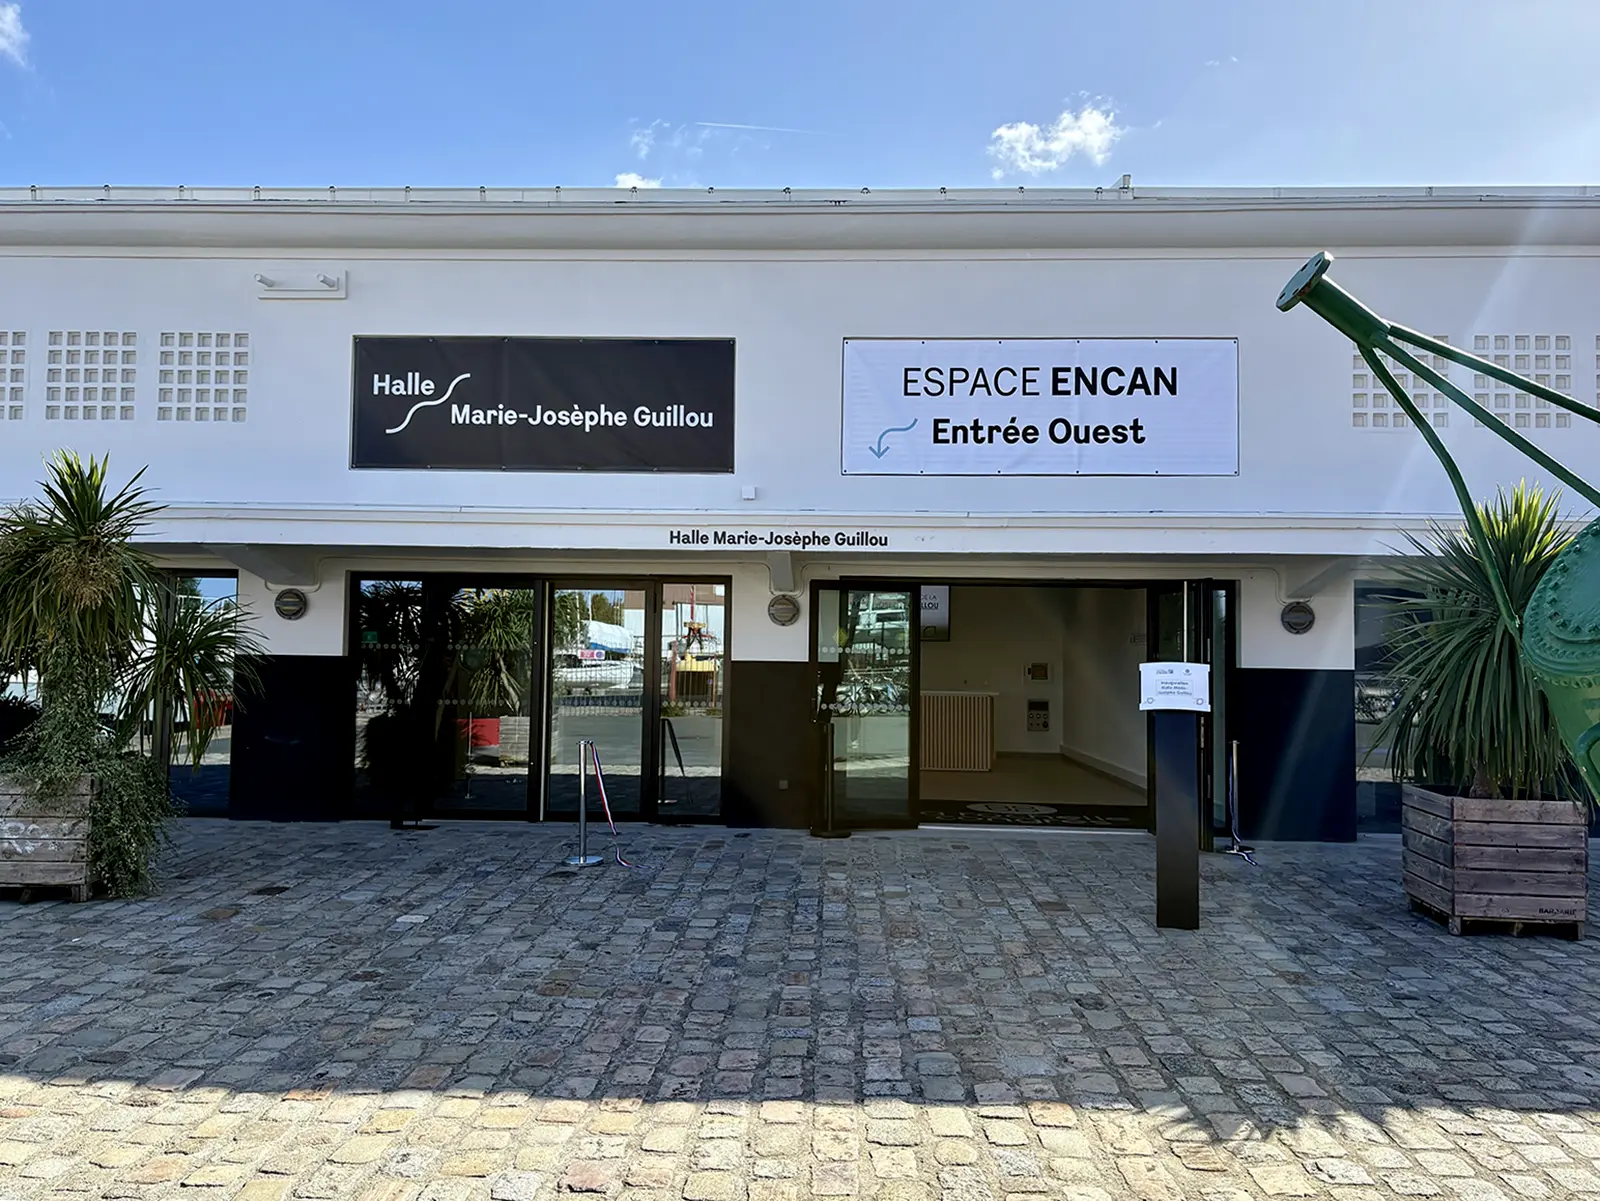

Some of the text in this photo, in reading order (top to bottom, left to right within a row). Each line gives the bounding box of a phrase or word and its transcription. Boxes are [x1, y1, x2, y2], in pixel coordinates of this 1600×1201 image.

[373, 371, 435, 396] Halle
[903, 366, 1178, 397] ESPACE ENCAN
[451, 403, 714, 433] Marie-Josèphe Guillou
[932, 416, 1146, 444] Entrée Ouest
[669, 529, 888, 549] Halle Marie-Josèphe Guillou
